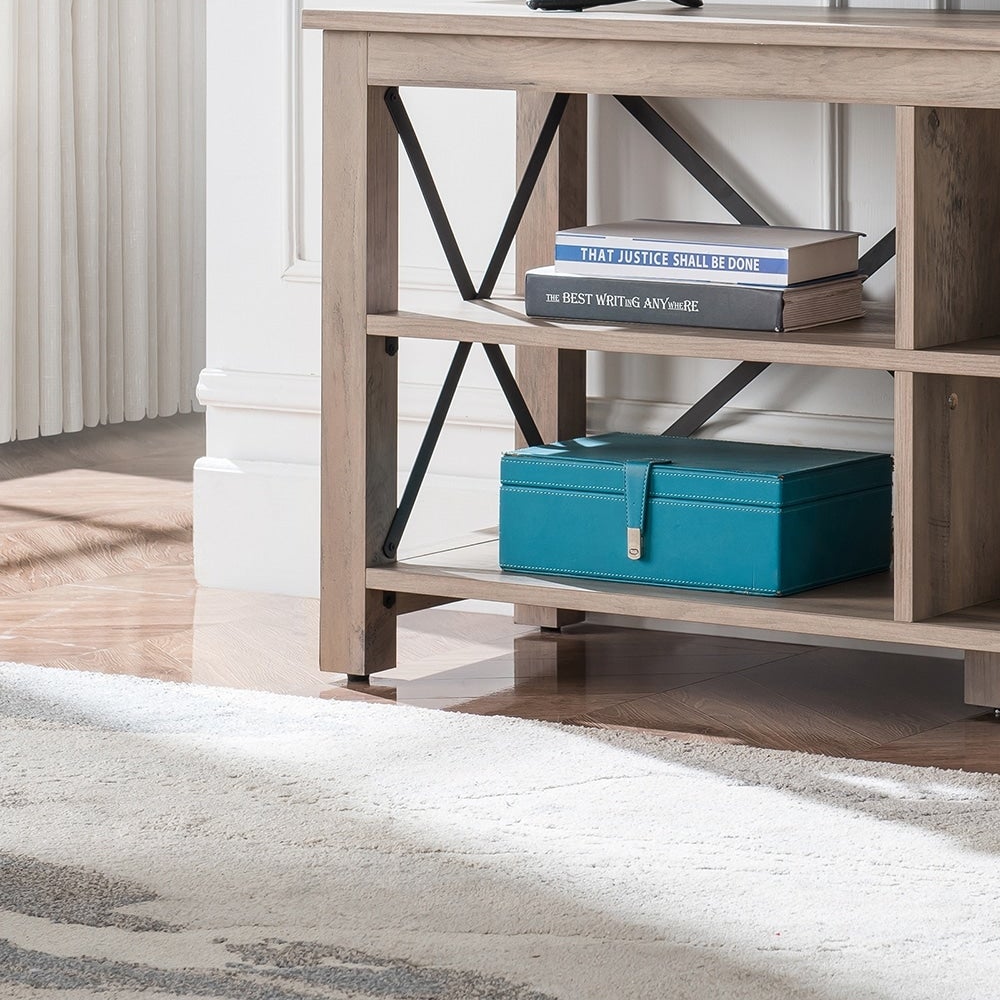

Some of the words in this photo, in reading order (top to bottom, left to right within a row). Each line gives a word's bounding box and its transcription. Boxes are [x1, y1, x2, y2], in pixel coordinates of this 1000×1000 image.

[581, 248, 614, 262] THAT
[618, 250, 669, 266] JUSTICE
[673, 253, 709, 269] SHALL
[711, 256, 726, 270] BE
[728, 257, 760, 272] DONE
[546, 293, 560, 303] THE
[562, 292, 593, 305] BEST
